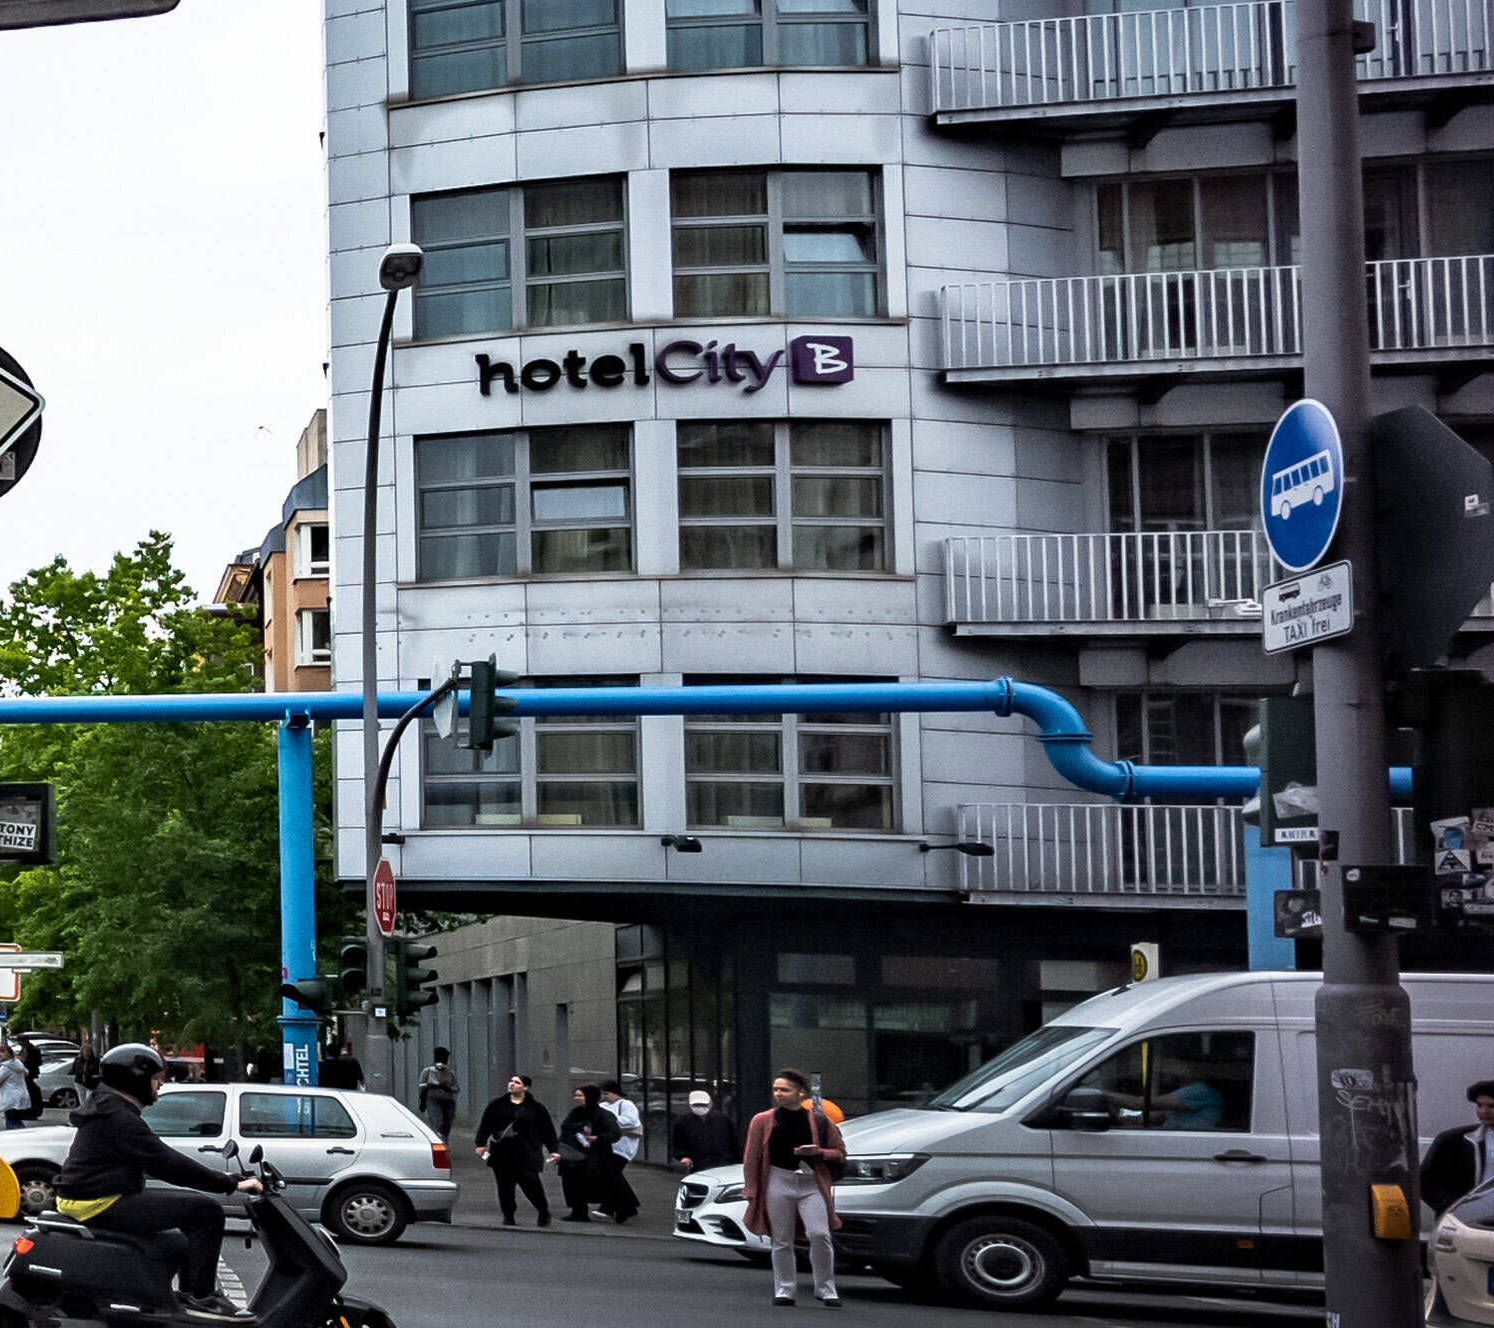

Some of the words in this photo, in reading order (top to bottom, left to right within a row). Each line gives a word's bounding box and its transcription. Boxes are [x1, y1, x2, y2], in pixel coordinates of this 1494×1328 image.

[1283, 621, 1308, 644] TAXI
[1311, 615, 1332, 637] frei
[376, 882, 394, 911] STOP
